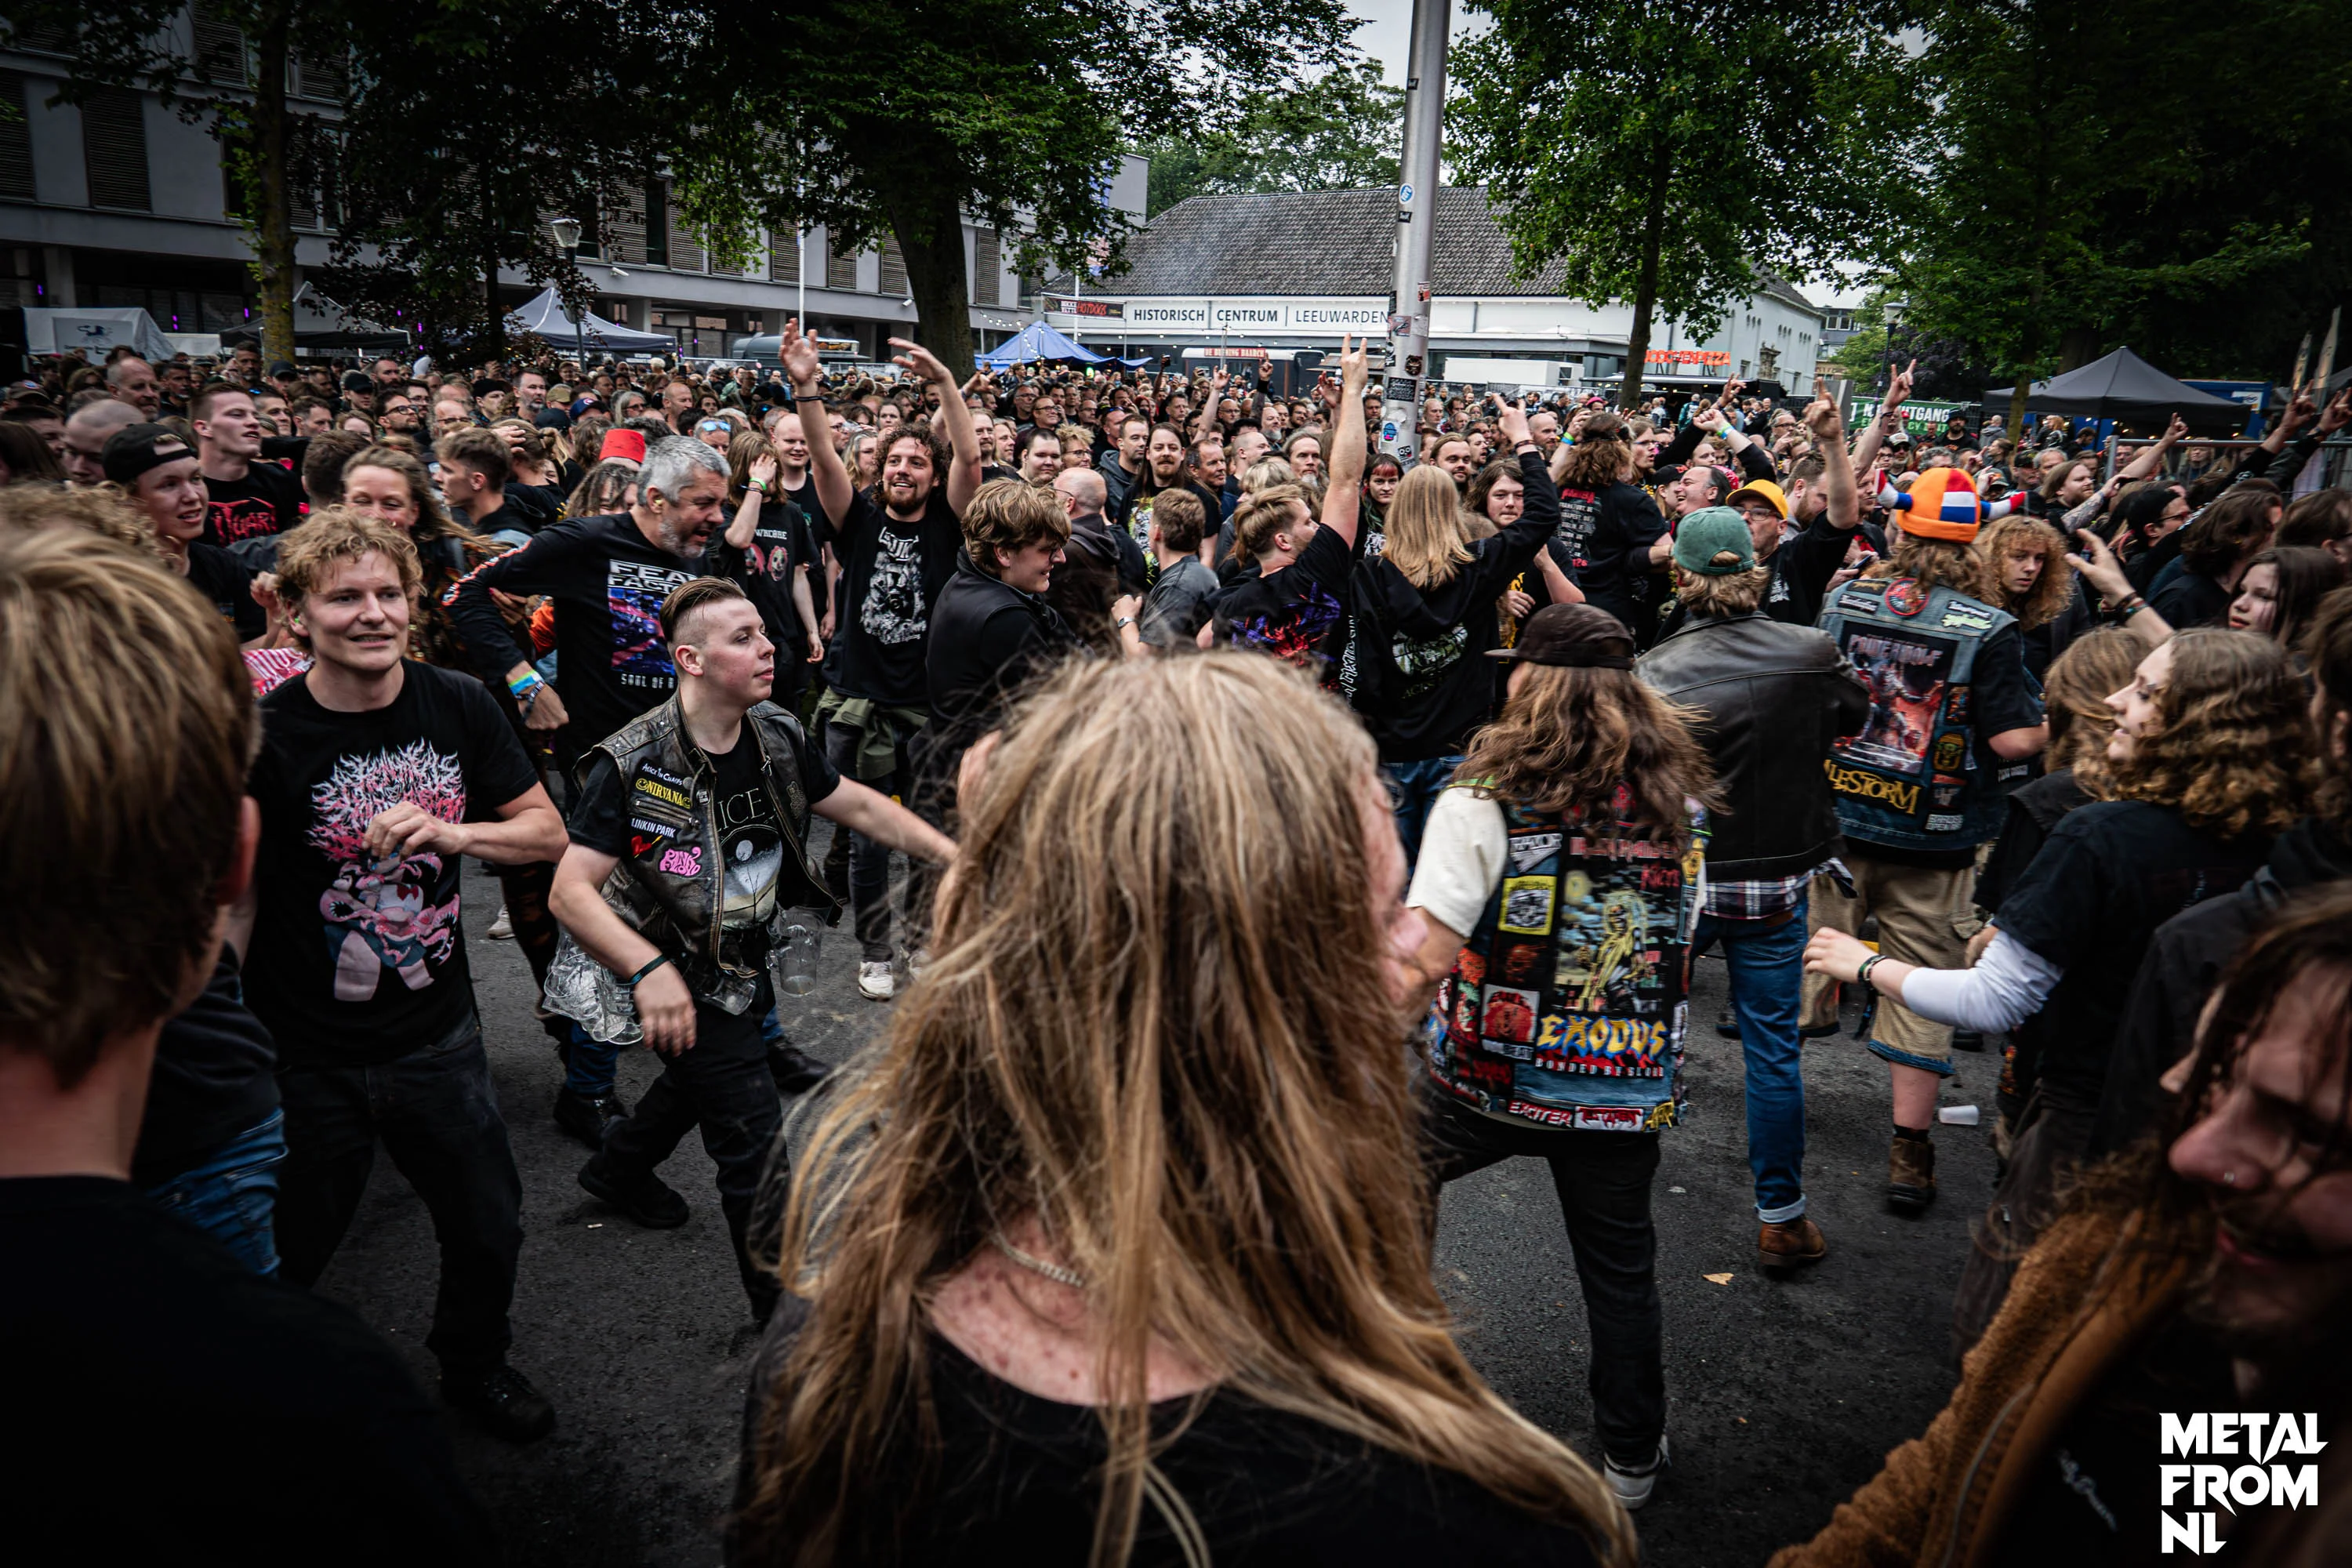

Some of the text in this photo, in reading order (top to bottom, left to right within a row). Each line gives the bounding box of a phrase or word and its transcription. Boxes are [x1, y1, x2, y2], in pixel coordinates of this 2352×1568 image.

[1077, 300, 1107, 316] HOTDOGS
[1134, 309, 1204, 321] HISTORISCH
[1217, 309, 1278, 321] CENTRUM
[1296, 310, 1388, 324] LEEUWARDEN
[621, 673, 648, 688] SOUL
[652, 677, 665, 689] OF
[642, 763, 658, 775] ALICE
[663, 773, 684, 786] CHAINS
[645, 780, 684, 808] NIRVANA
[716, 788, 765, 832] ICE
[631, 818, 677, 839] LINKIN PARK
[664, 846, 702, 867] PINK
[659, 861, 702, 877] FLOYD
[1536, 1014, 1671, 1059] EXODUS
[1534, 1058, 1599, 1075] BONDED
[1603, 1065, 1621, 1077] BY
[1508, 1100, 1574, 1128] EXCITER
